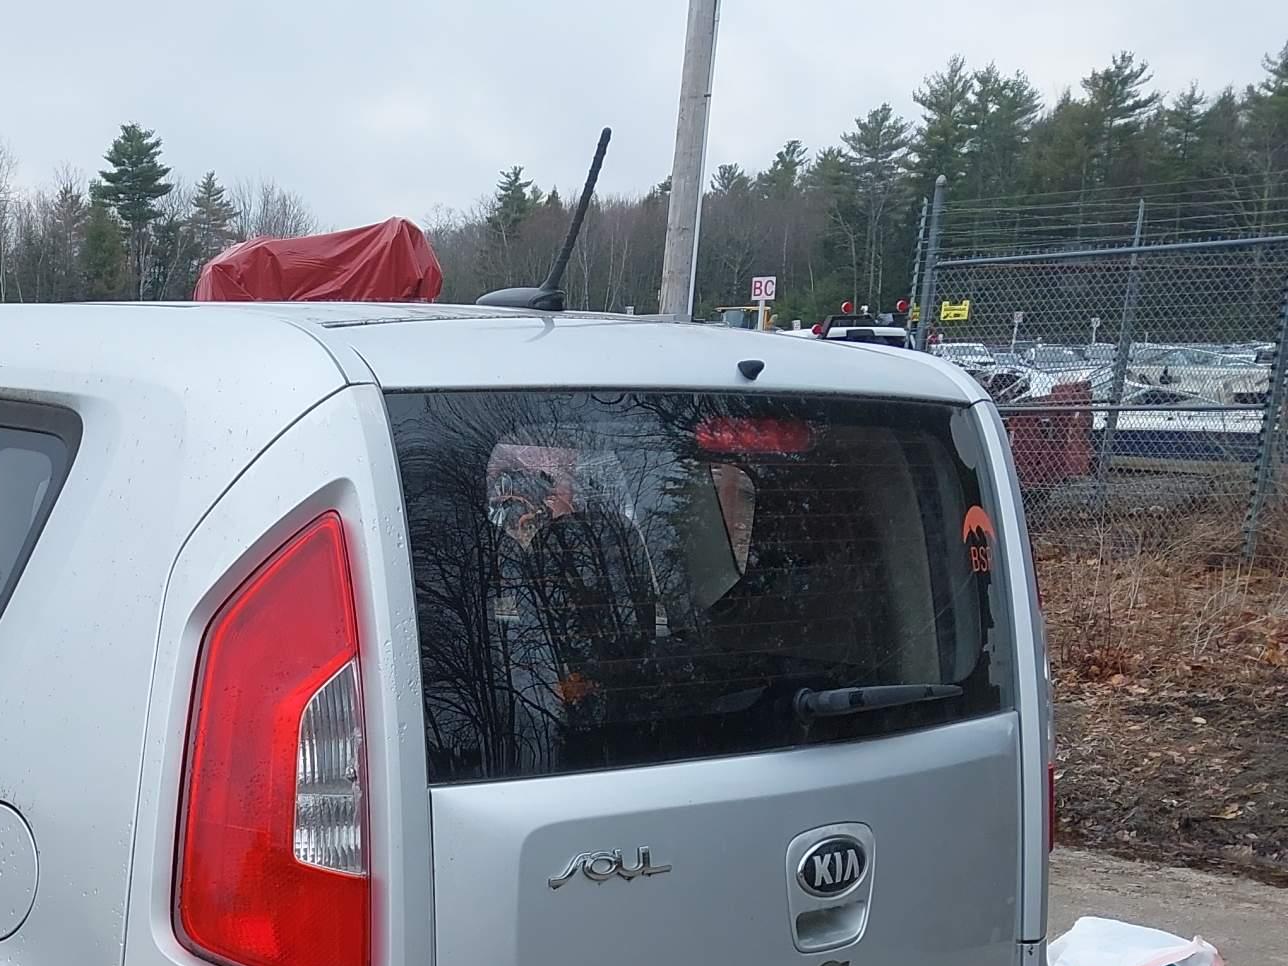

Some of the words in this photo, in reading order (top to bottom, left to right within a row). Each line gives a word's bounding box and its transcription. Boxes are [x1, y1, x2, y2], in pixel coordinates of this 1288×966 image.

[753, 280, 774, 297] BC
[548, 846, 672, 890] SOUL
[813, 849, 860, 886] KIA
